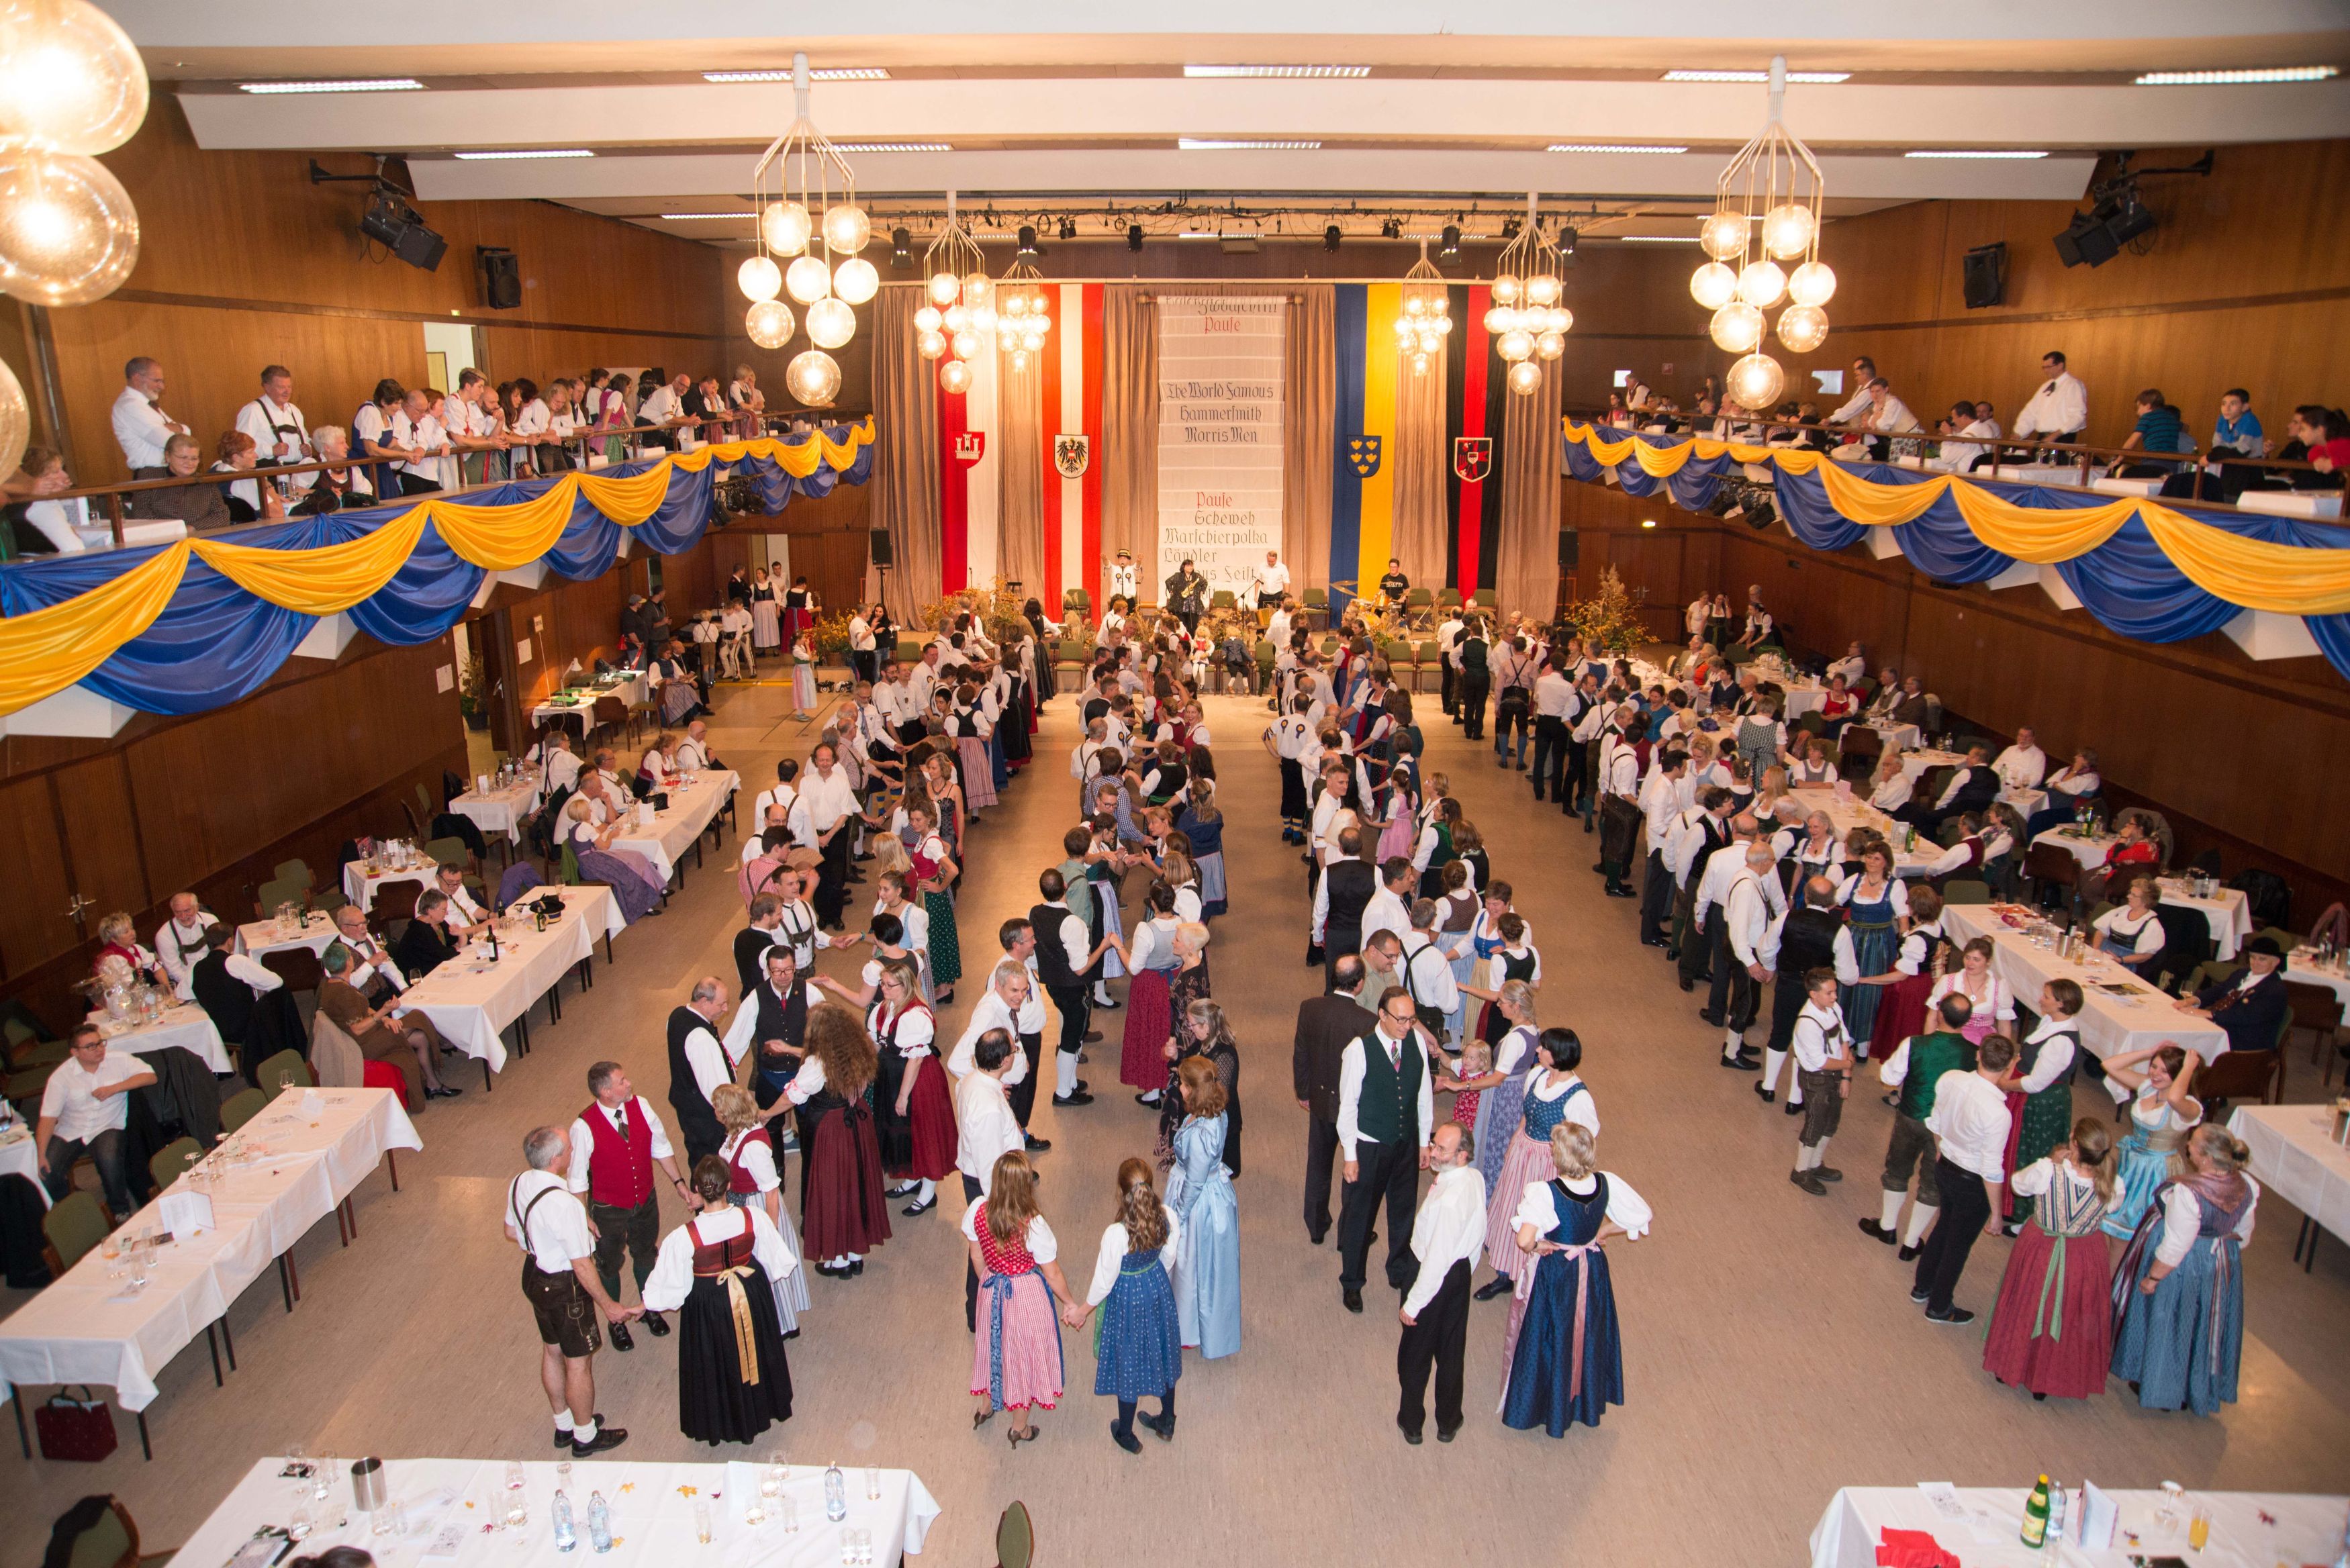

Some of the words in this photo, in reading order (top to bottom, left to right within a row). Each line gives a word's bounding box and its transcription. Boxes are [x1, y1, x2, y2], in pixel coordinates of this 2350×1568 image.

[1166, 383, 1188, 401] The
[1188, 382, 1223, 398] World
[1226, 382, 1274, 401] Famous
[1185, 427, 1228, 443] Morris
[1231, 427, 1258, 443] Men
[1164, 548, 1218, 562] Ländler
